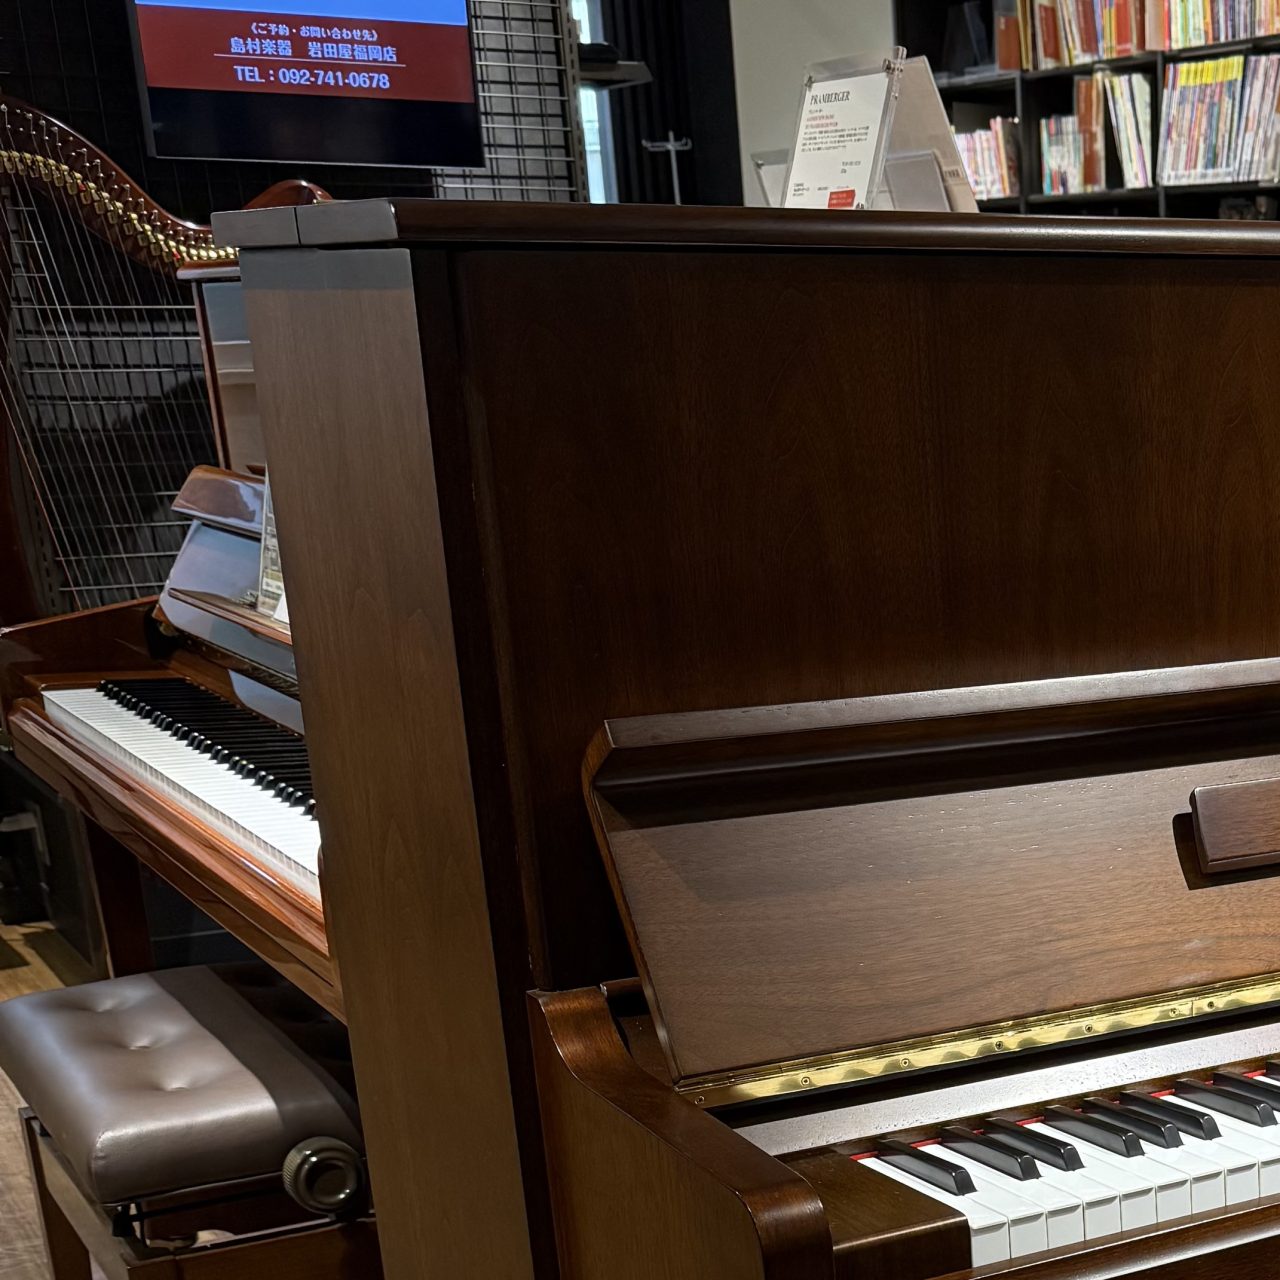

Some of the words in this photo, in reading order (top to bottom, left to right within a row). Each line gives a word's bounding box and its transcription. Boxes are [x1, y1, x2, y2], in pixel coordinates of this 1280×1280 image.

[230, 37, 292, 56] 島村楽器
[308, 41, 398, 62] 岩田屋福岡店
